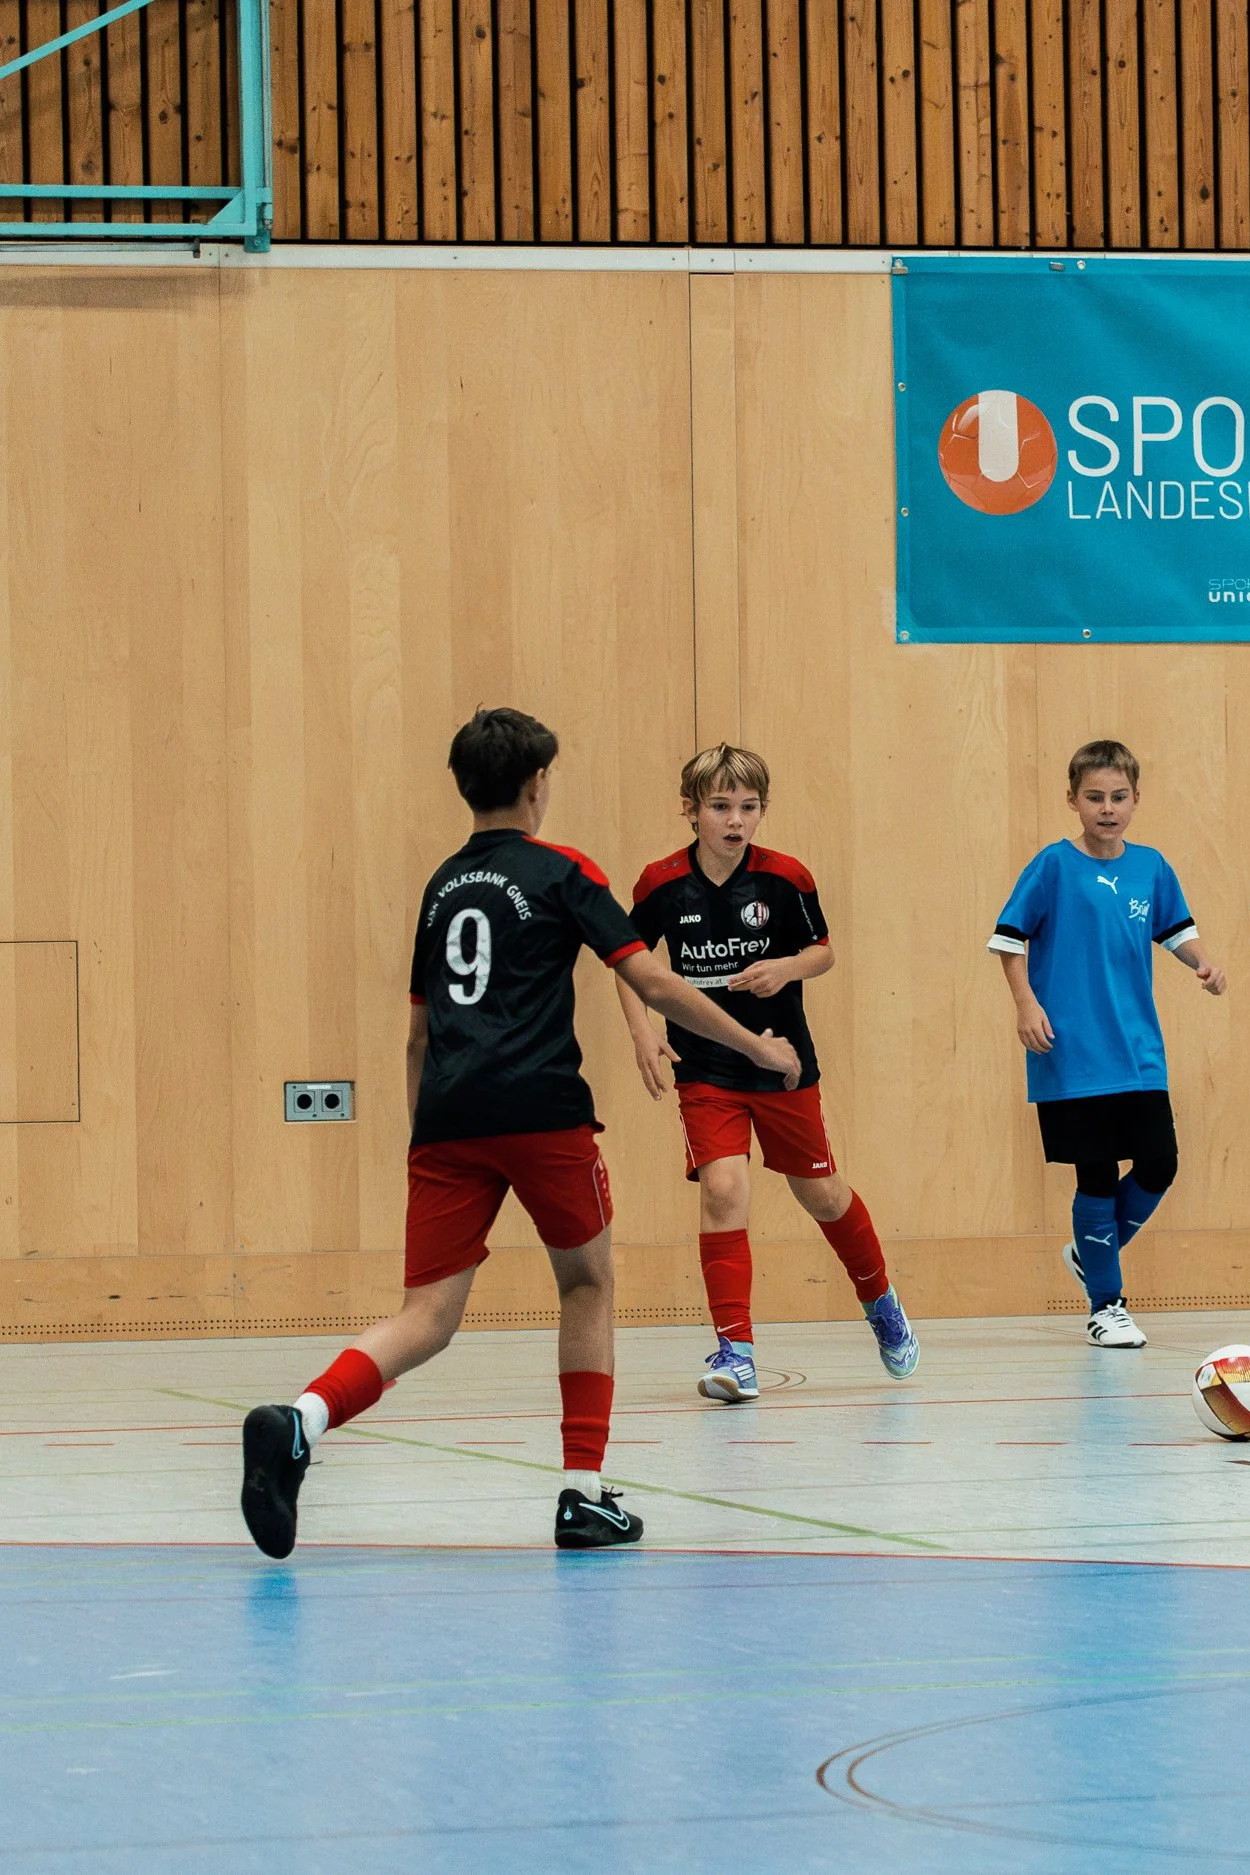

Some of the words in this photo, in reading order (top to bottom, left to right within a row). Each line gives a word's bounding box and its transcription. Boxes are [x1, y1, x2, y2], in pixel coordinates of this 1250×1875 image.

[437, 871, 509, 898] VOLKSBANK
[506, 884, 532, 921] GNEIS
[679, 913, 702, 925] JAKO
[446, 908, 492, 1005] 9
[680, 937, 771, 960] AutoFrey
[696, 963, 712, 973] tun
